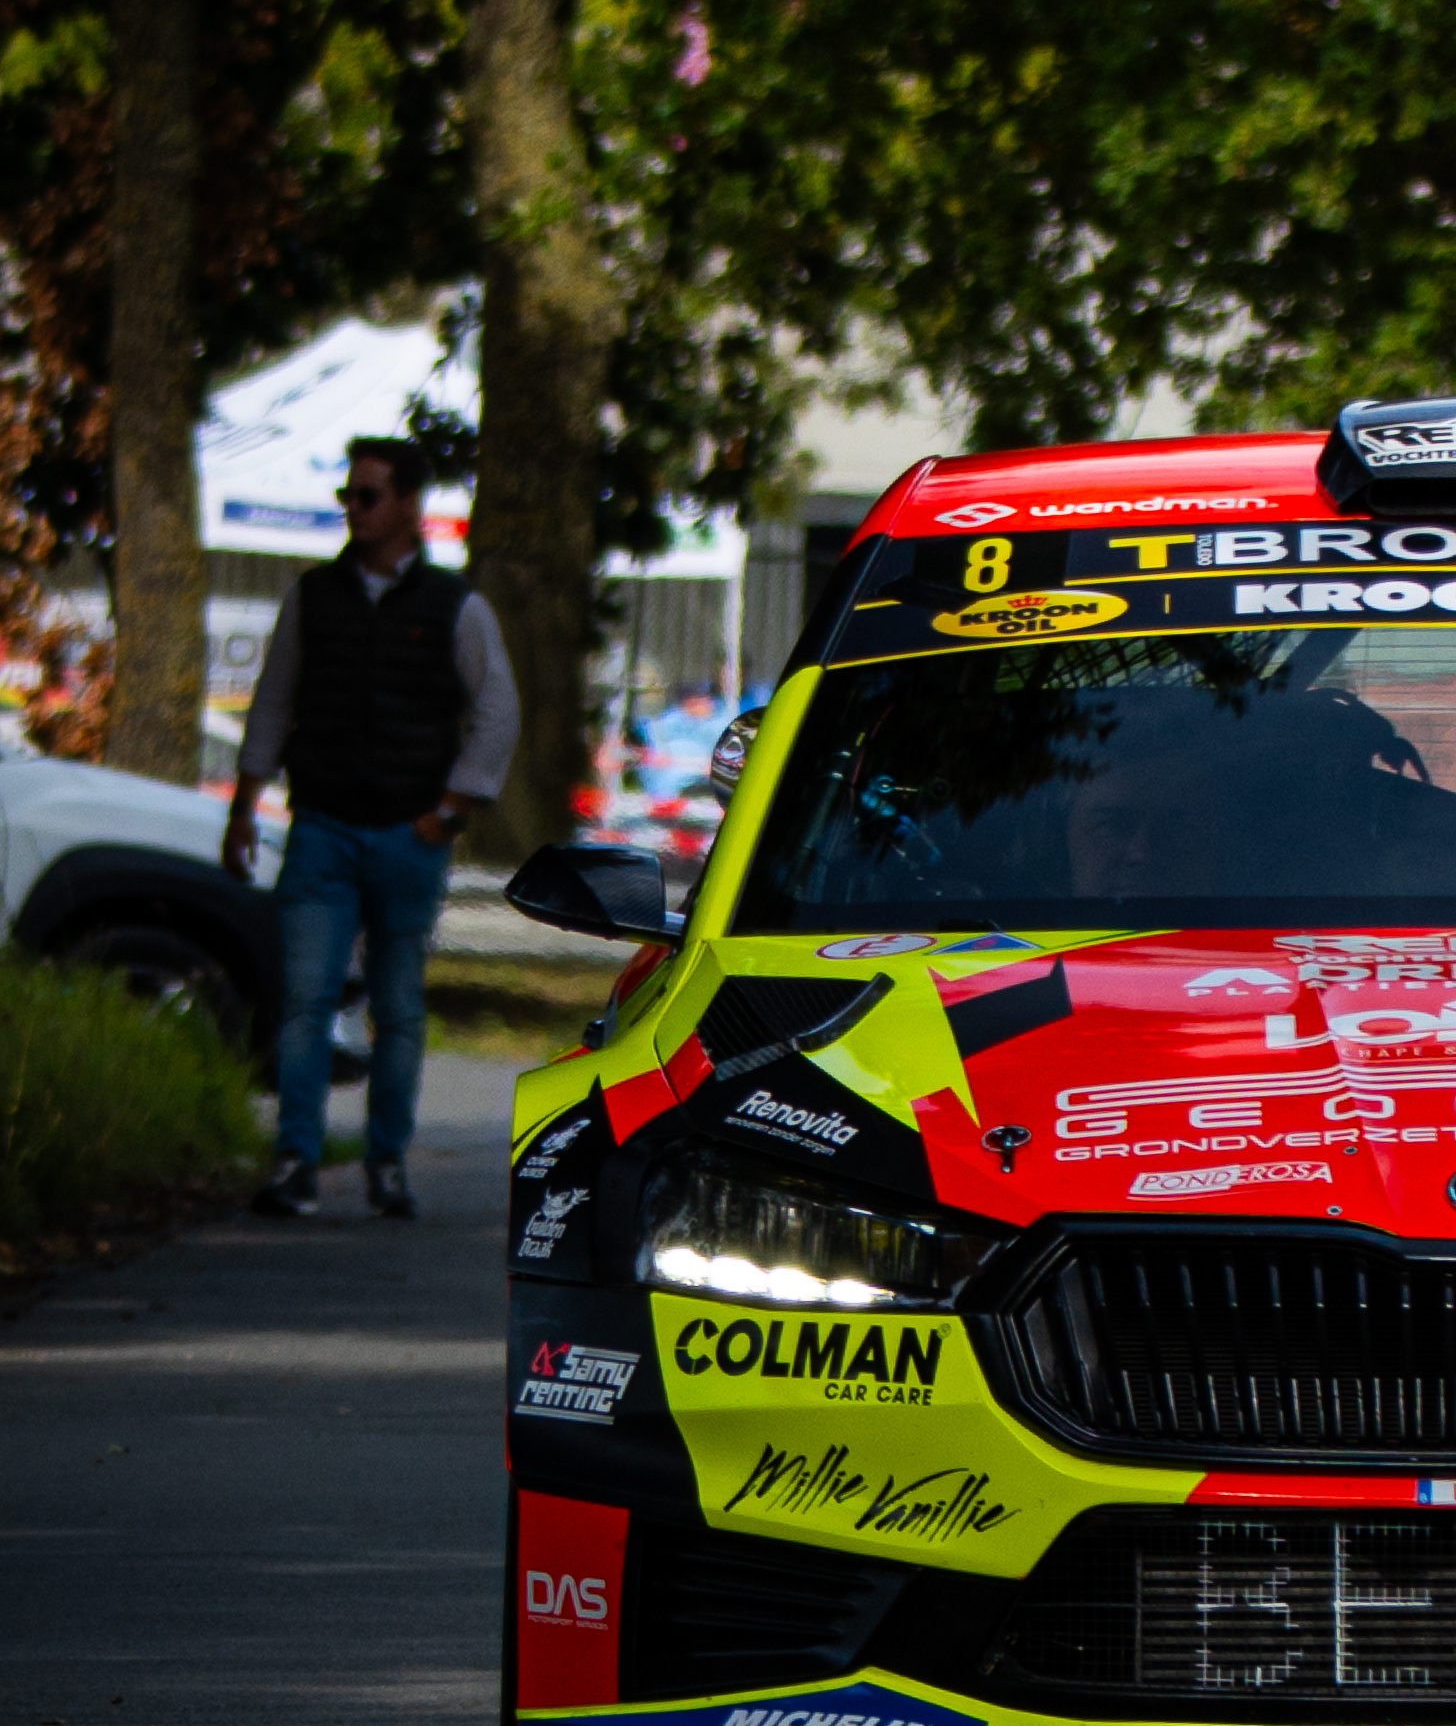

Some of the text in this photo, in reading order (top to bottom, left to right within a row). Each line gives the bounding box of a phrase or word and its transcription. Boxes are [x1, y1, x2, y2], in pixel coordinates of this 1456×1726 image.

[963, 537, 1013, 593] 8
[960, 602, 1099, 625] KROON
[996, 617, 1058, 635] OIL
[736, 1090, 859, 1145] Renovita
[1140, 1161, 1333, 1190] PONDEROSA
[675, 1318, 943, 1386] COLMAN
[824, 1382, 934, 1407] CAR CARE
[526, 1570, 609, 1620] DAS
